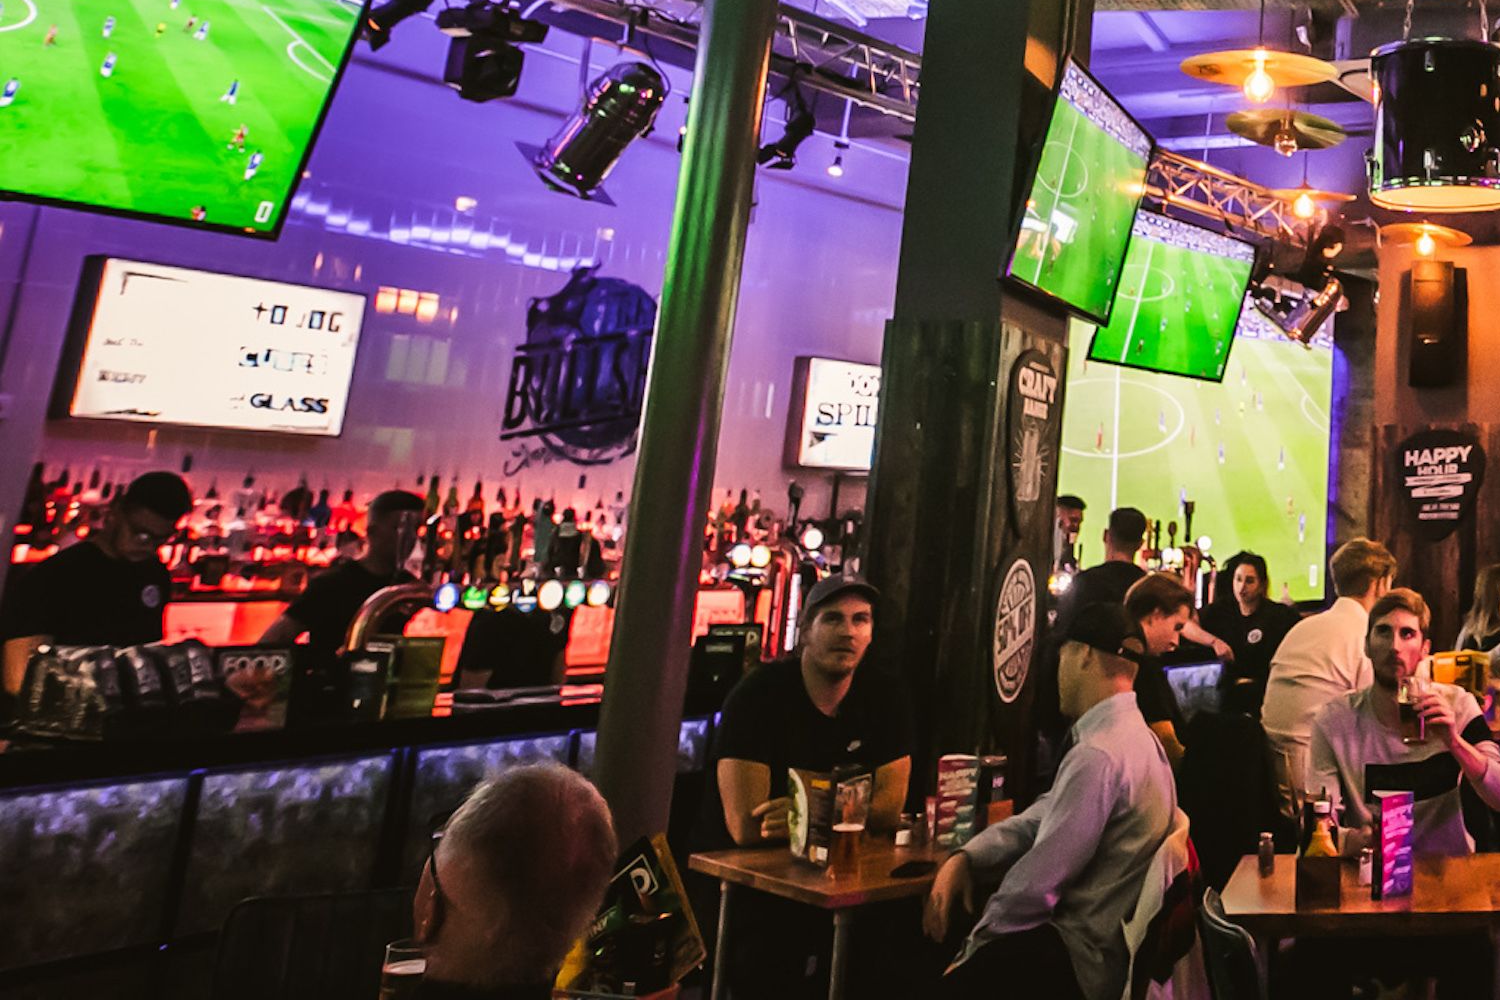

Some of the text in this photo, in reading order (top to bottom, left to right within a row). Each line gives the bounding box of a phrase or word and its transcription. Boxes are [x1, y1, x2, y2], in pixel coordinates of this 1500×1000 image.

[250, 393, 329, 414] GLASS
[1404, 445, 1473, 467] HAPPY
[1416, 462, 1459, 476] HOUR
[224, 655, 287, 675] FOOD
